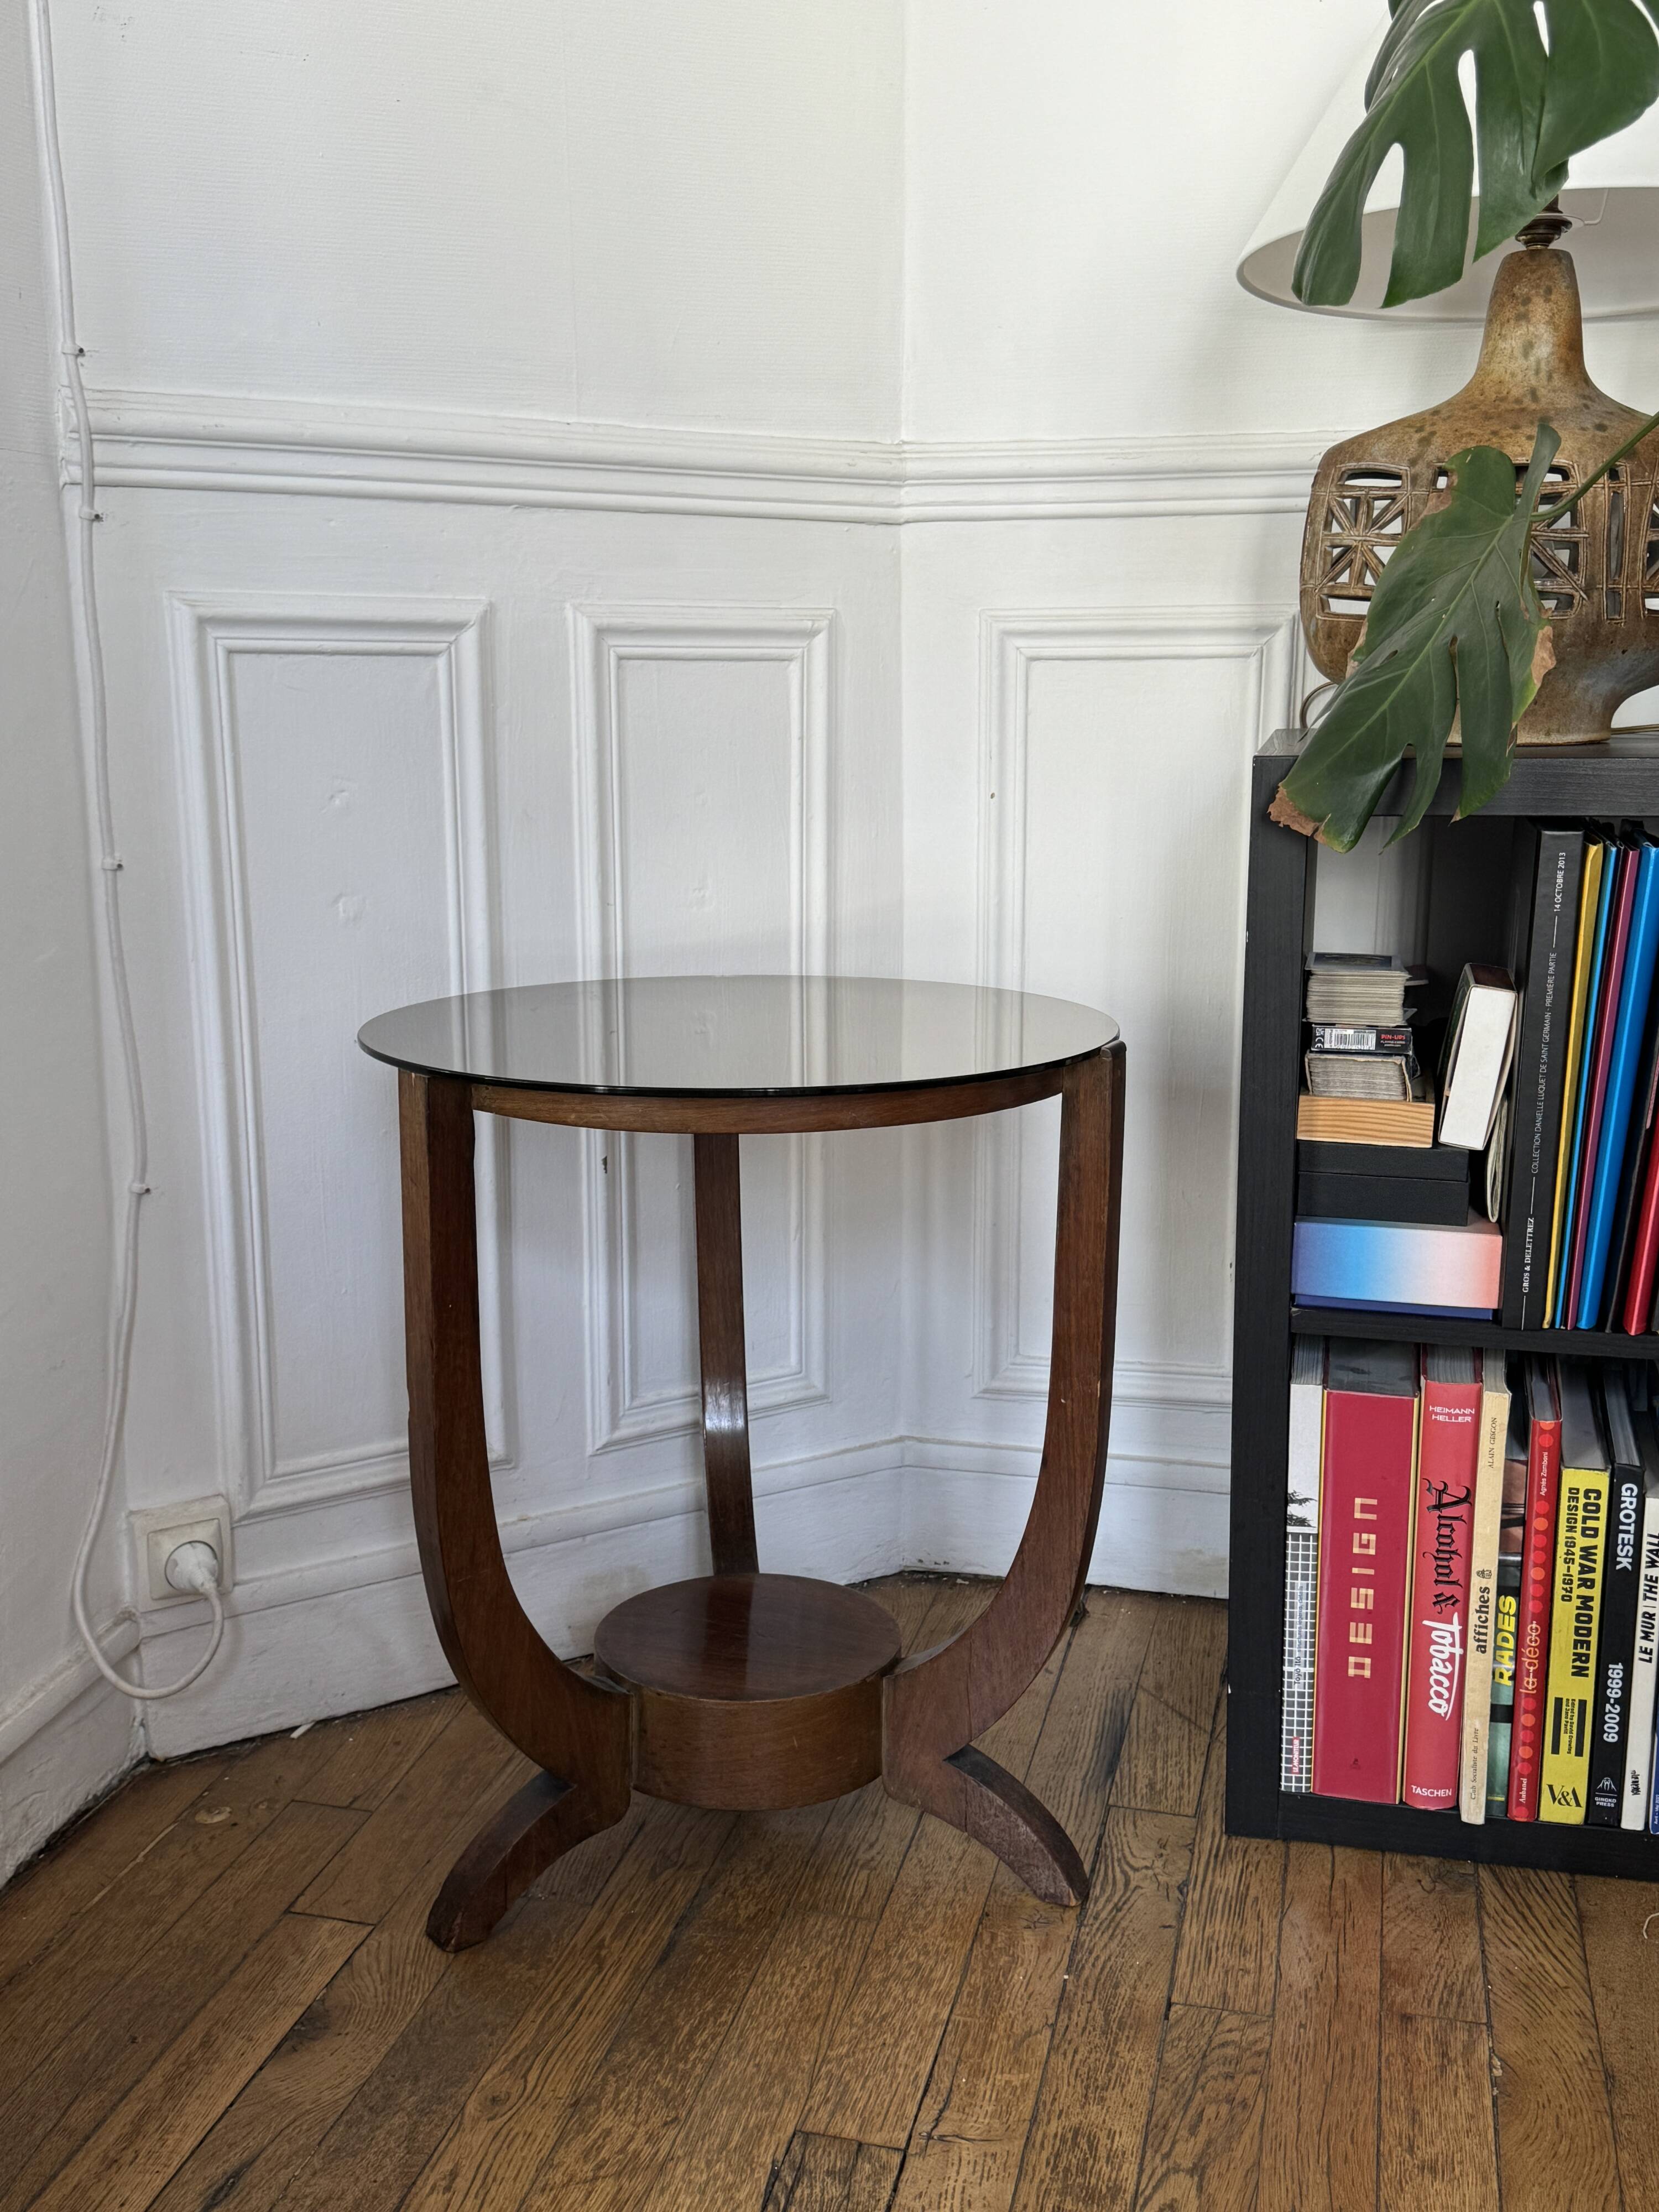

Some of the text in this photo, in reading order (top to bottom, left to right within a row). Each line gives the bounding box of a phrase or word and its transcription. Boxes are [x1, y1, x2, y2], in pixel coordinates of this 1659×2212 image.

[1554, 870, 1564, 902] OCTOBRE
[1548, 952, 1557, 974] PARTIE
[1542, 1012, 1551, 1042] GERMAIN
[1540, 1064, 1547, 1073] DE
[1537, 1074, 1546, 1100] LUQUET
[1535, 1102, 1543, 1132] DANIELLE
[1532, 1134, 1541, 1173] COLLECTION
[1525, 1217, 1534, 1263] DELETTREZ
[1429, 1405, 1475, 1414] HEIMANN
[1432, 1414, 1472, 1422] HELLER
[1566, 1487, 1580, 1533] DESIGN
[1616, 1483, 1638, 1571] GROTESK
[1422, 1478, 1472, 1615] Alcohol &
[1645, 1532, 1659, 1569] WALL
[1348, 1498, 1378, 1678] DESIGN
[1571, 1489, 1601, 1678] COLD WAR MODERN
[1642, 1574, 1658, 1601] THE
[1473, 1586, 1490, 1654] affiches
[1640, 1611, 1656, 1642] MUR
[1494, 1595, 1516, 1686] RADES
[1638, 1646, 1653, 1663] LE
[1422, 1612, 1464, 1721] Tobacco
[1519, 1624, 1541, 1694] la déco
[1603, 1662, 1624, 1743] 1999-2009
[1472, 1745, 1478, 1754] du
[1411, 1785, 1452, 1797] TASCHEN
[1519, 1778, 1527, 1803] Aubanel
[1546, 1784, 1583, 1808] V&A
